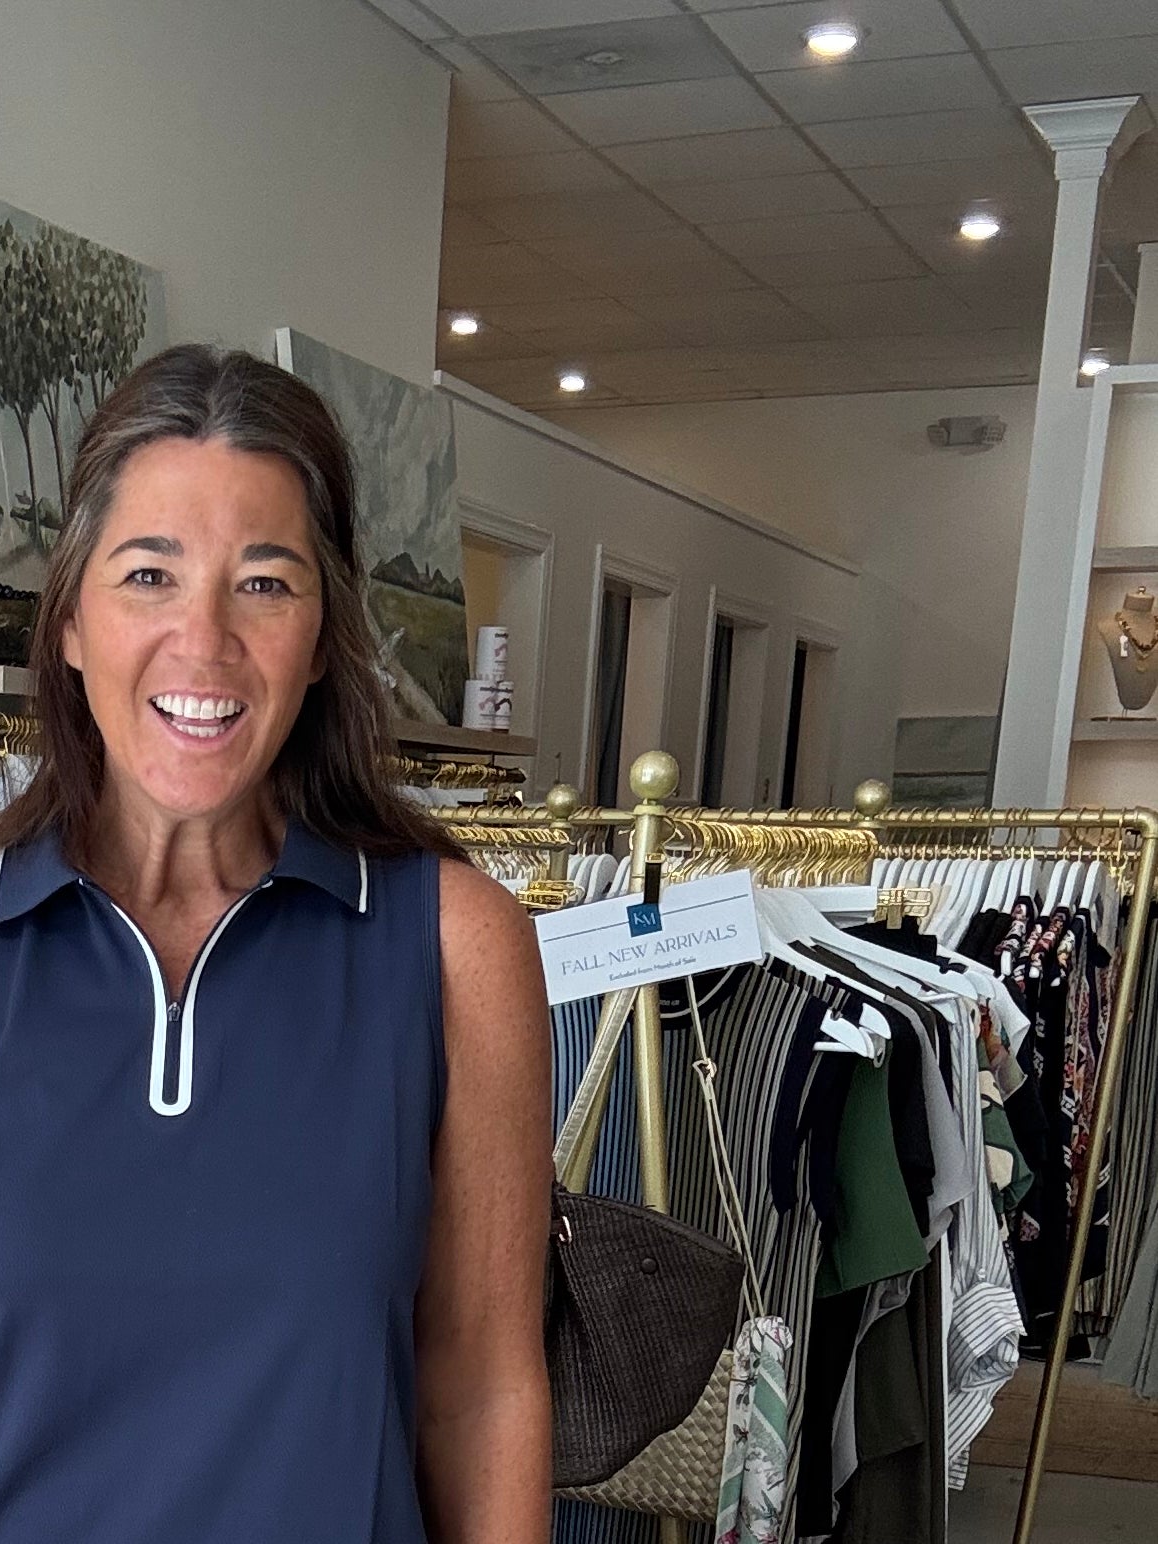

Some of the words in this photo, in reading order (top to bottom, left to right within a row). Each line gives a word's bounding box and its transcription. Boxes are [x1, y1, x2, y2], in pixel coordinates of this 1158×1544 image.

[561, 954, 606, 976] FALL
[608, 942, 649, 967] NEW
[653, 923, 738, 956] ARRIVALS
